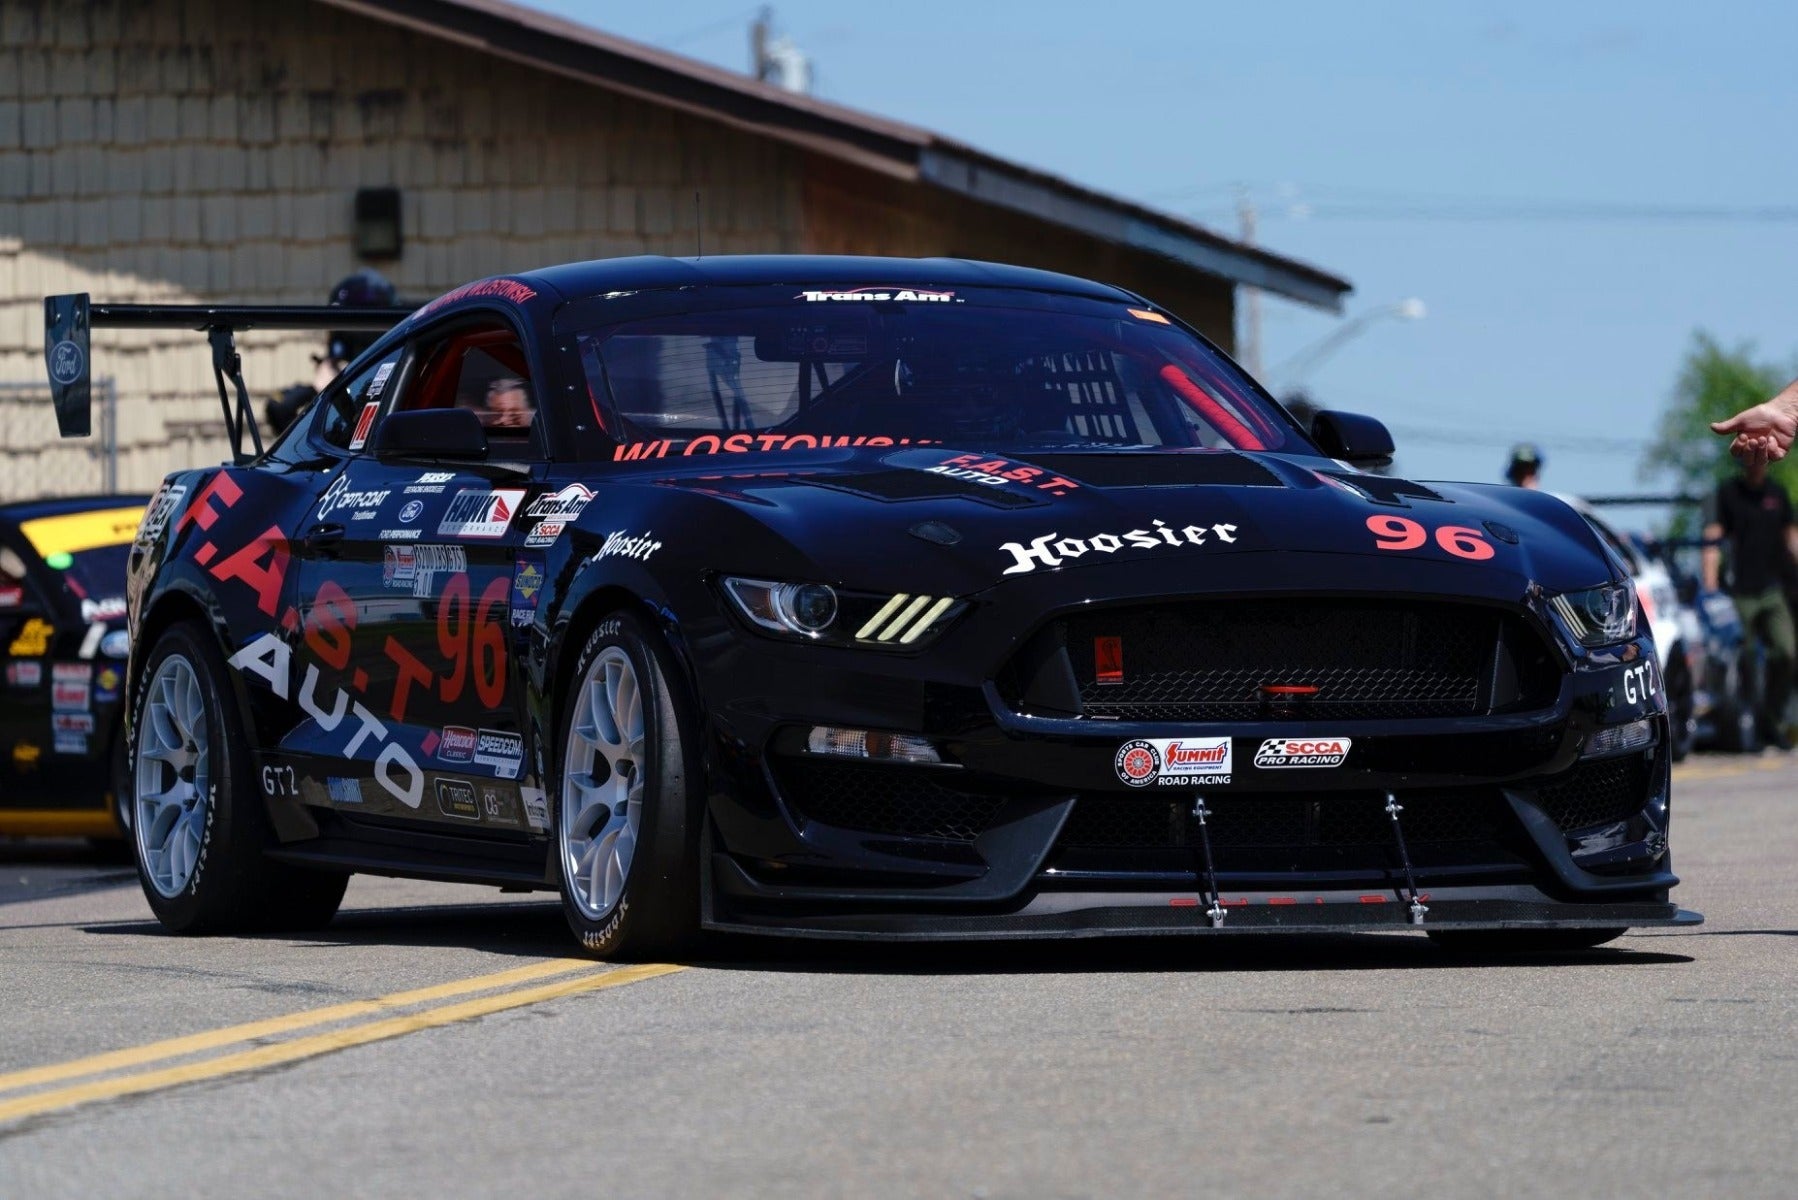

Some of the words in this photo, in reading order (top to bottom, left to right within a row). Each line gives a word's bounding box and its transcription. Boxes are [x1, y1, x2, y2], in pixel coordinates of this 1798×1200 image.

[802, 291, 892, 302] Trans
[891, 291, 952, 302] Am
[55, 345, 77, 376] Ford
[924, 465, 1010, 485] AUTO
[444, 495, 499, 523] HAWK
[525, 494, 565, 515] Trans
[561, 494, 588, 515] Am
[540, 525, 561, 535] SCCA
[1366, 515, 1495, 560] 96
[591, 528, 662, 563] Hoosier
[998, 519, 1238, 575] Hoosier
[437, 572, 511, 709] 96
[577, 620, 621, 676] Hoosier
[1623, 660, 1656, 705] GT2
[227, 632, 424, 809] AUTO
[1118, 743, 1134, 767] SPORTS
[1135, 741, 1150, 750] CAR
[1150, 749, 1160, 765] CLUB
[1257, 756, 1287, 766] PRO
[1289, 755, 1341, 765] RACING
[1285, 741, 1344, 755] SCCA
[262, 764, 299, 796] GT2
[1121, 771, 1130, 781] OF
[1130, 770, 1158, 785] AMERICA
[1158, 776, 1189, 786] ROAD
[1191, 775, 1231, 785] RACING
[582, 891, 630, 948] Hoosier
